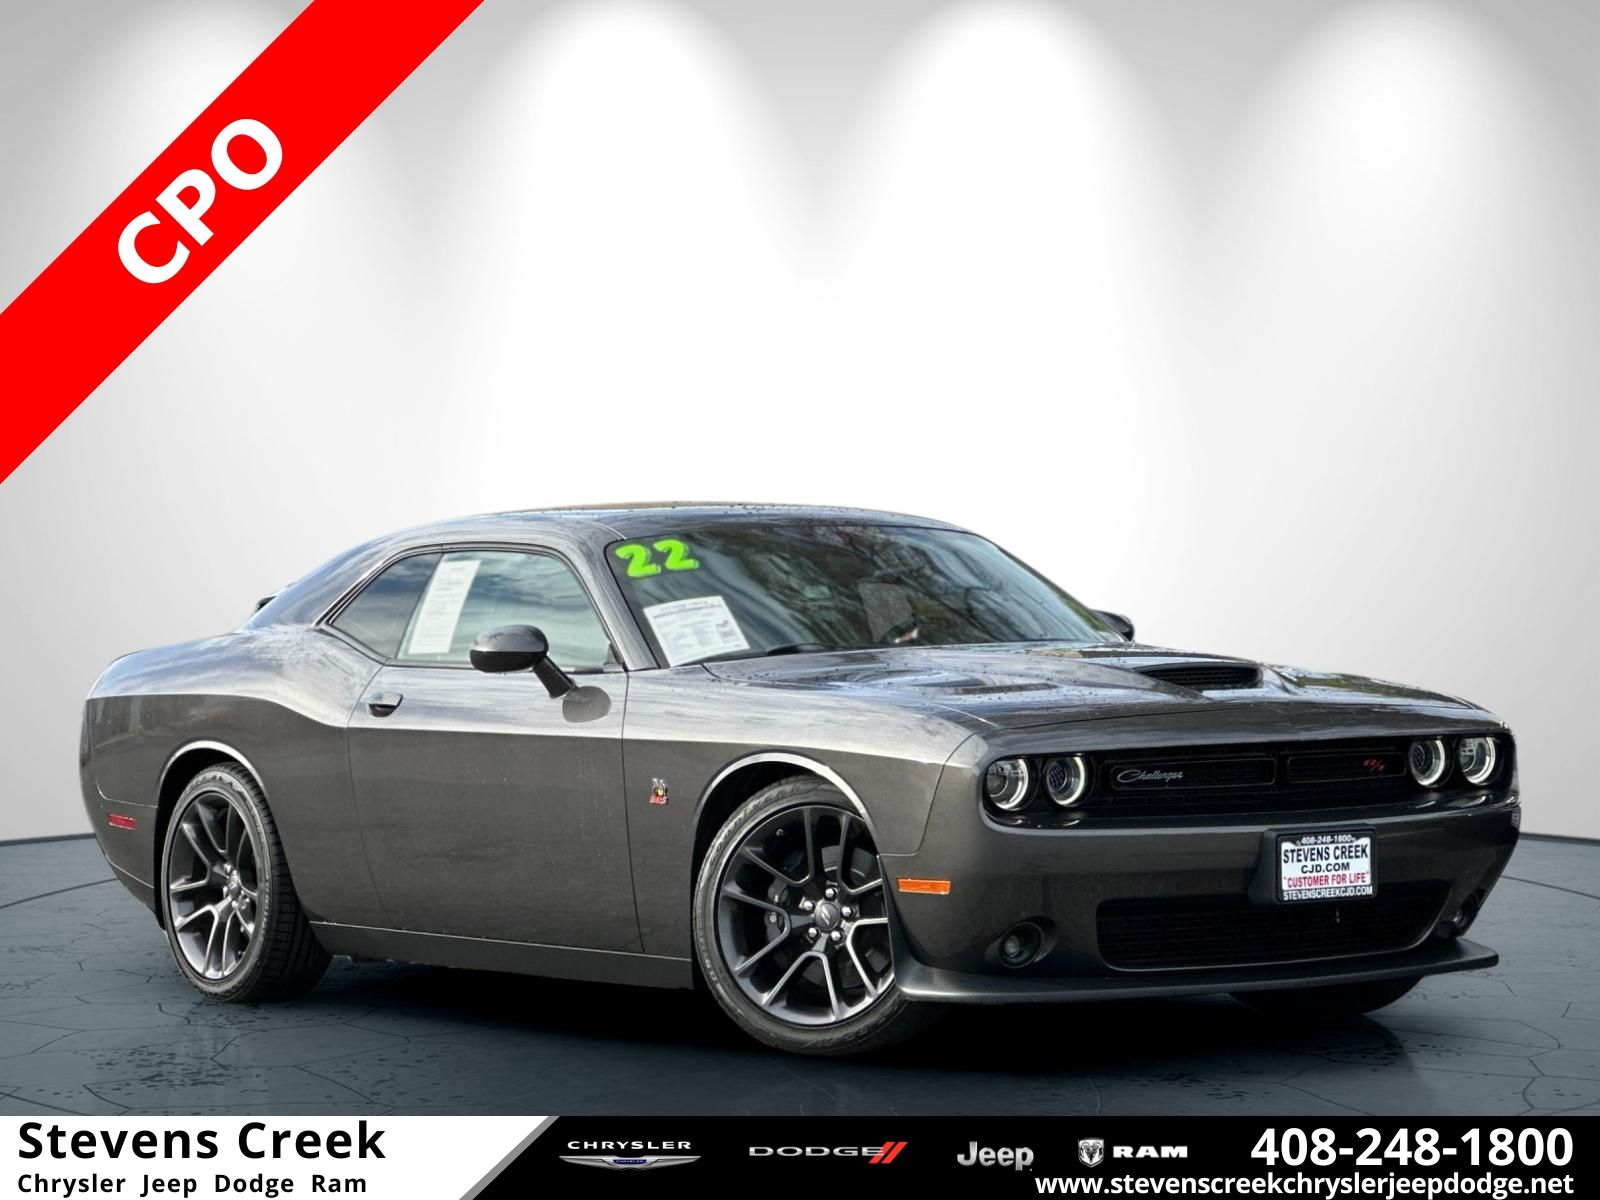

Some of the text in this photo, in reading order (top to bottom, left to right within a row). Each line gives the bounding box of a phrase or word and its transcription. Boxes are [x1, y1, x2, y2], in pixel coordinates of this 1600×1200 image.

[615, 539, 699, 577] 22
[1116, 769, 1184, 783] Challenger
[1301, 834, 1352, 845] 408-248-1800
[1283, 844, 1368, 864] STEVENS CREEK
[1301, 862, 1350, 874] CJD.COM
[1331, 874, 1347, 885] FOR
[1283, 885, 1373, 901] STEVENSCREEKCJD.COM
